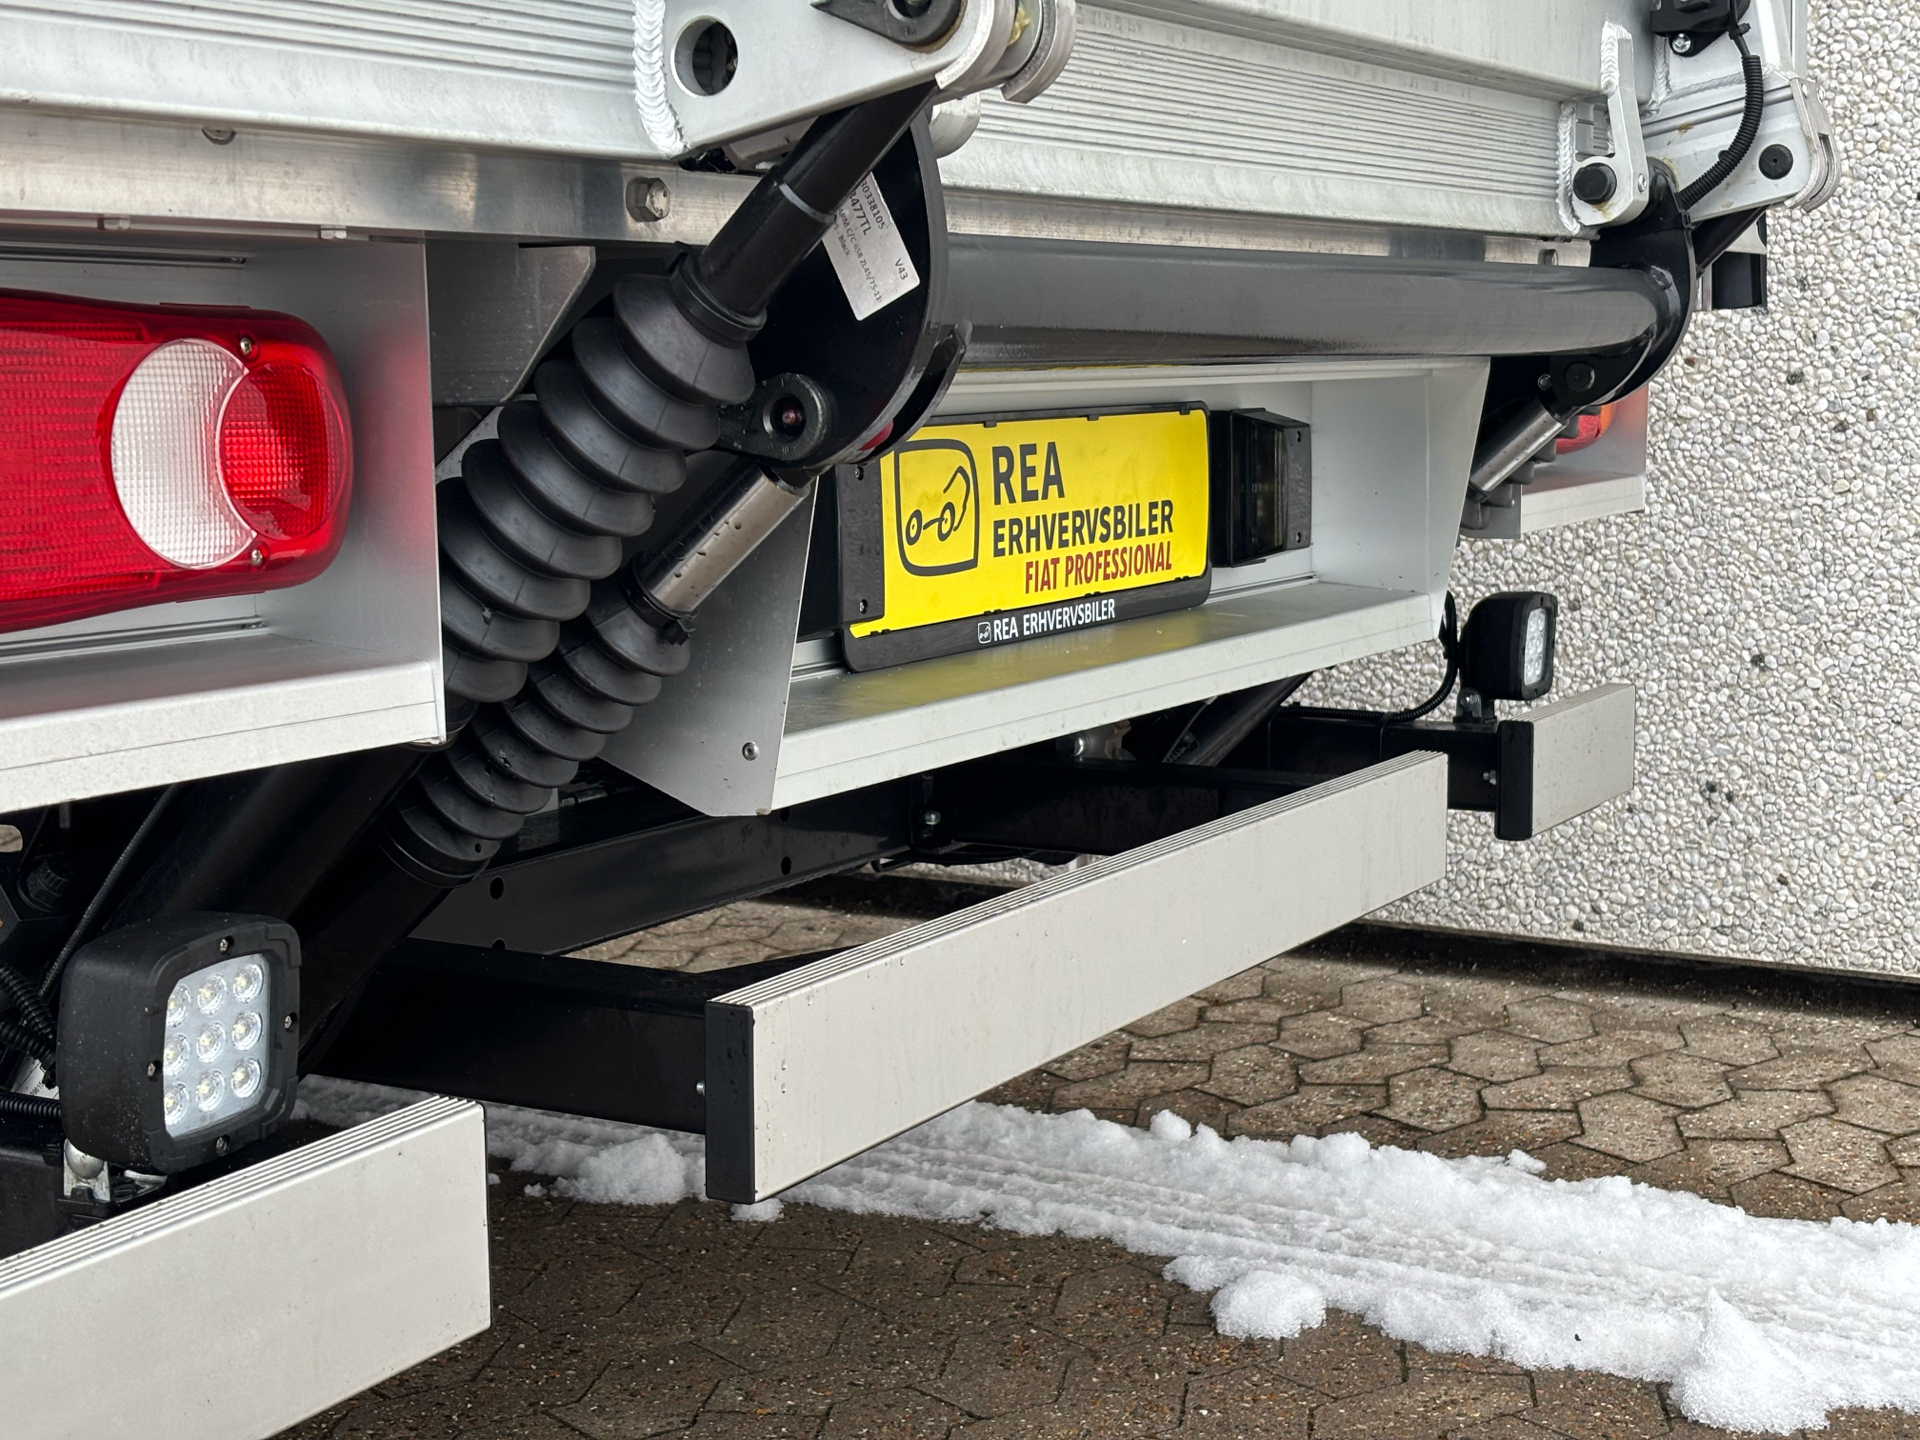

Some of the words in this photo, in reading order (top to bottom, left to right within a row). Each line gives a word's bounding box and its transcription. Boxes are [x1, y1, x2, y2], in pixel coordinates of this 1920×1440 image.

[838, 235, 851, 257] Black
[847, 228, 857, 243] C/C
[895, 258, 908, 280] V43
[992, 442, 1065, 505] REA
[993, 499, 1173, 557] ERHVERVSBILER
[1025, 557, 1060, 594] FIAT
[1065, 541, 1172, 587] PROFESSIONAL
[993, 617, 1019, 642] REA
[1023, 598, 1115, 635] ERHVERVSBILER
